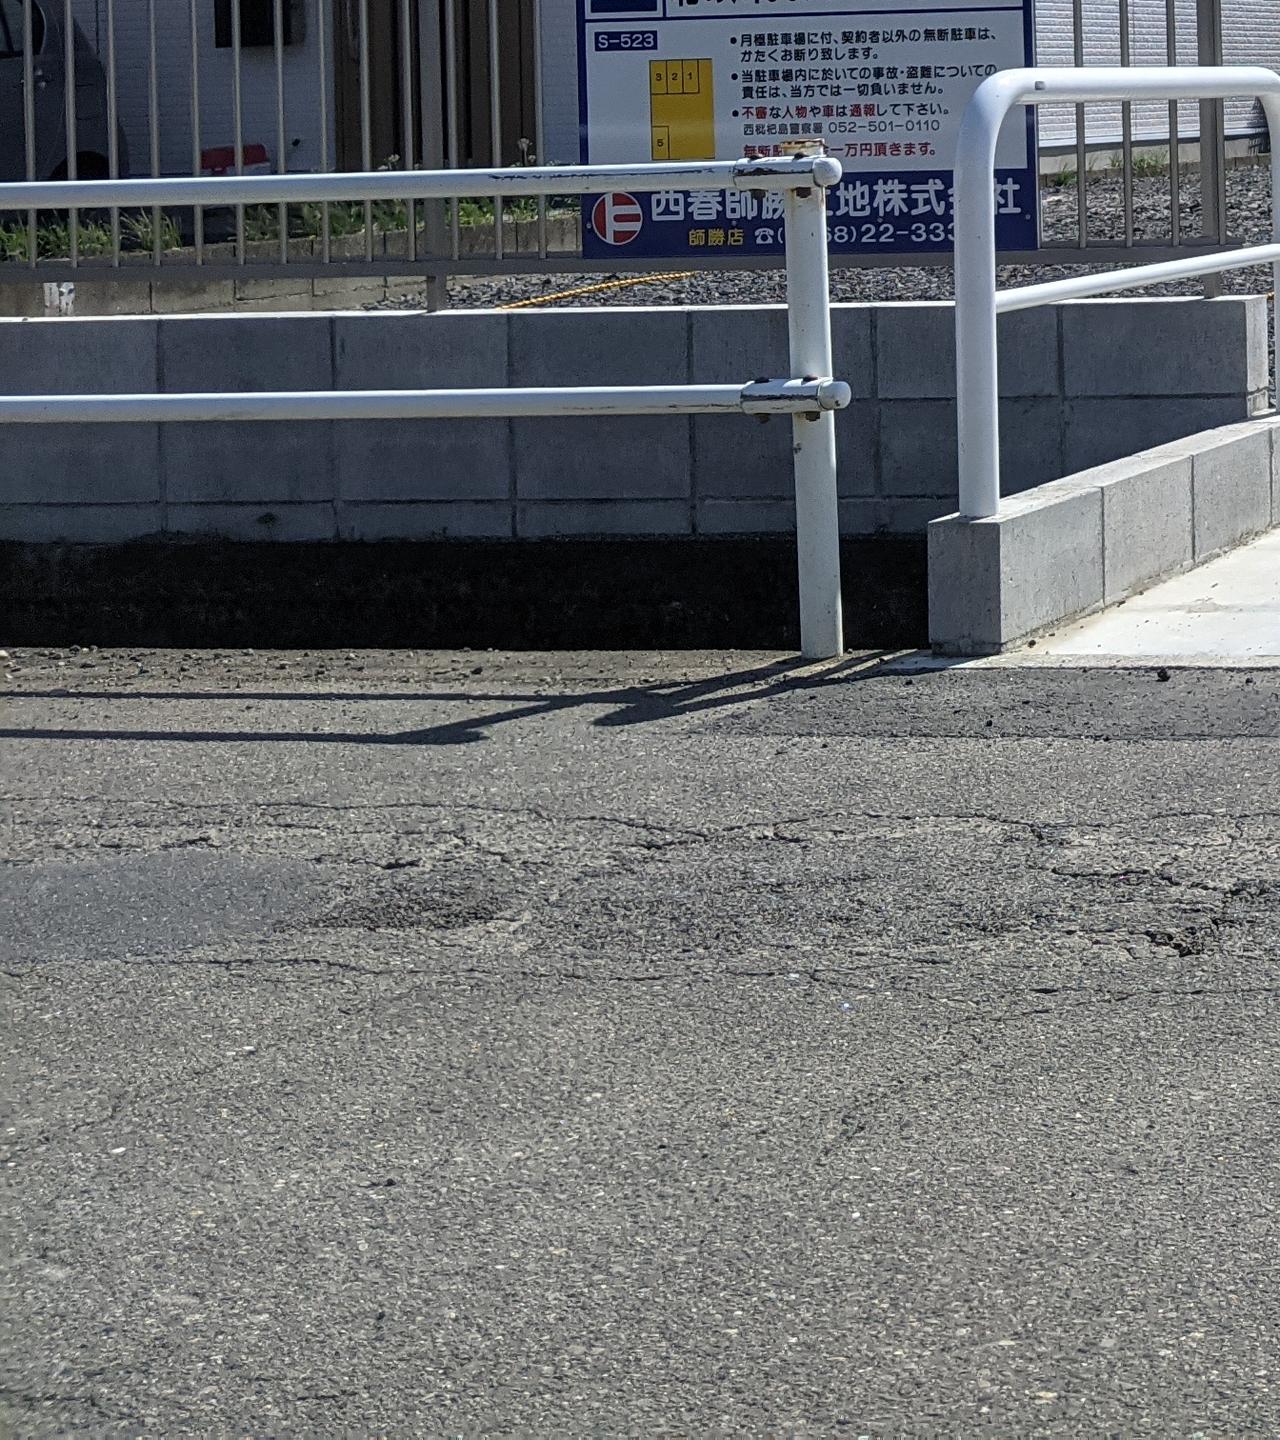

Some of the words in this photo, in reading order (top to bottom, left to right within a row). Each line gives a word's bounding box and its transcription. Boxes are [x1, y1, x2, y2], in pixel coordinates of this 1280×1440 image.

[598, 33, 655, 49] S-523
[740, 46, 878, 63] かたくお断り致します。
[655, 72, 662, 81] 3
[671, 72, 678, 81] 2
[828, 119, 940, 134] 052-501-0110
[656, 138, 664, 148] 5
[688, 227, 745, 246] 師勝店
